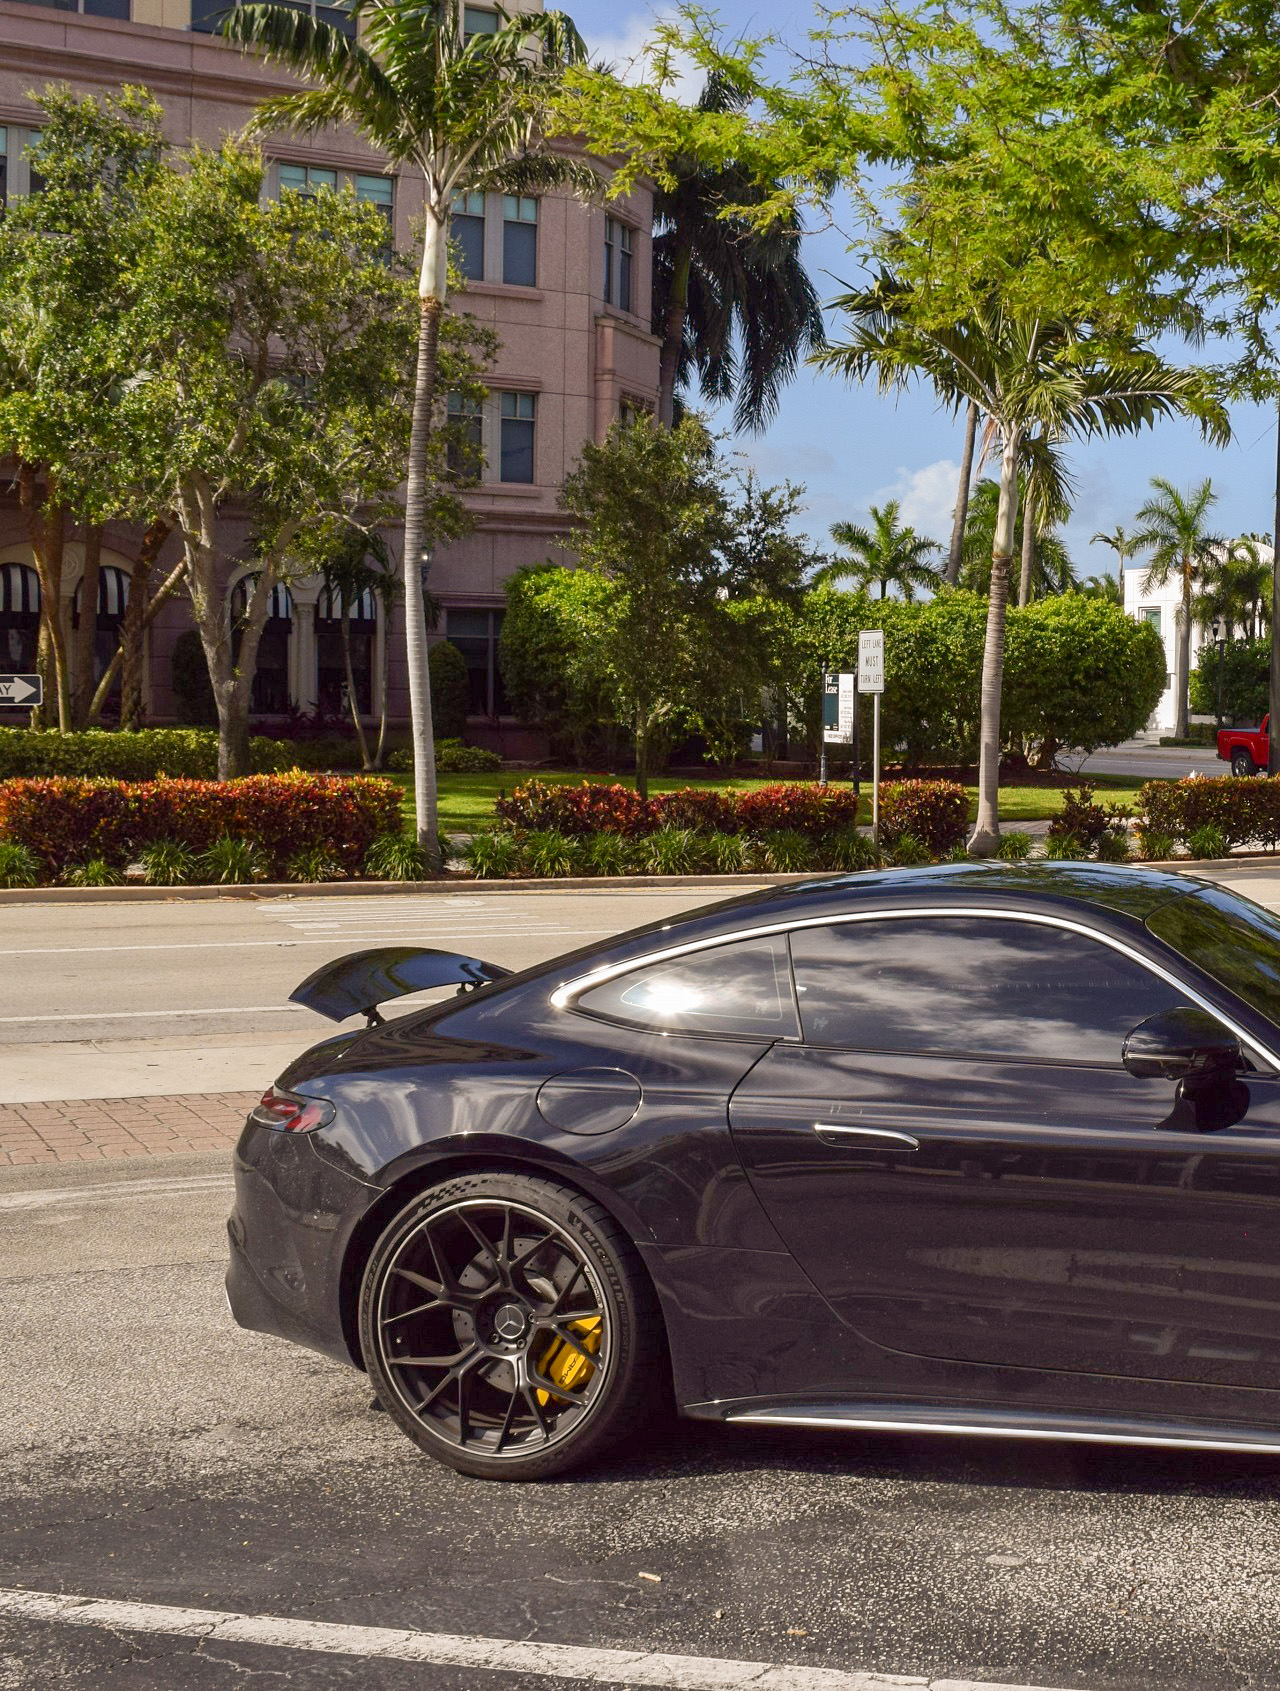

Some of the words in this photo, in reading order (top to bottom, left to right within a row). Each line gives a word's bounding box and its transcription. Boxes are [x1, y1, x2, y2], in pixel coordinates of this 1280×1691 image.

[864, 655, 879, 667] MUST
[825, 684, 838, 694] Lease
[583, 1231, 624, 1304] MICHELIN
